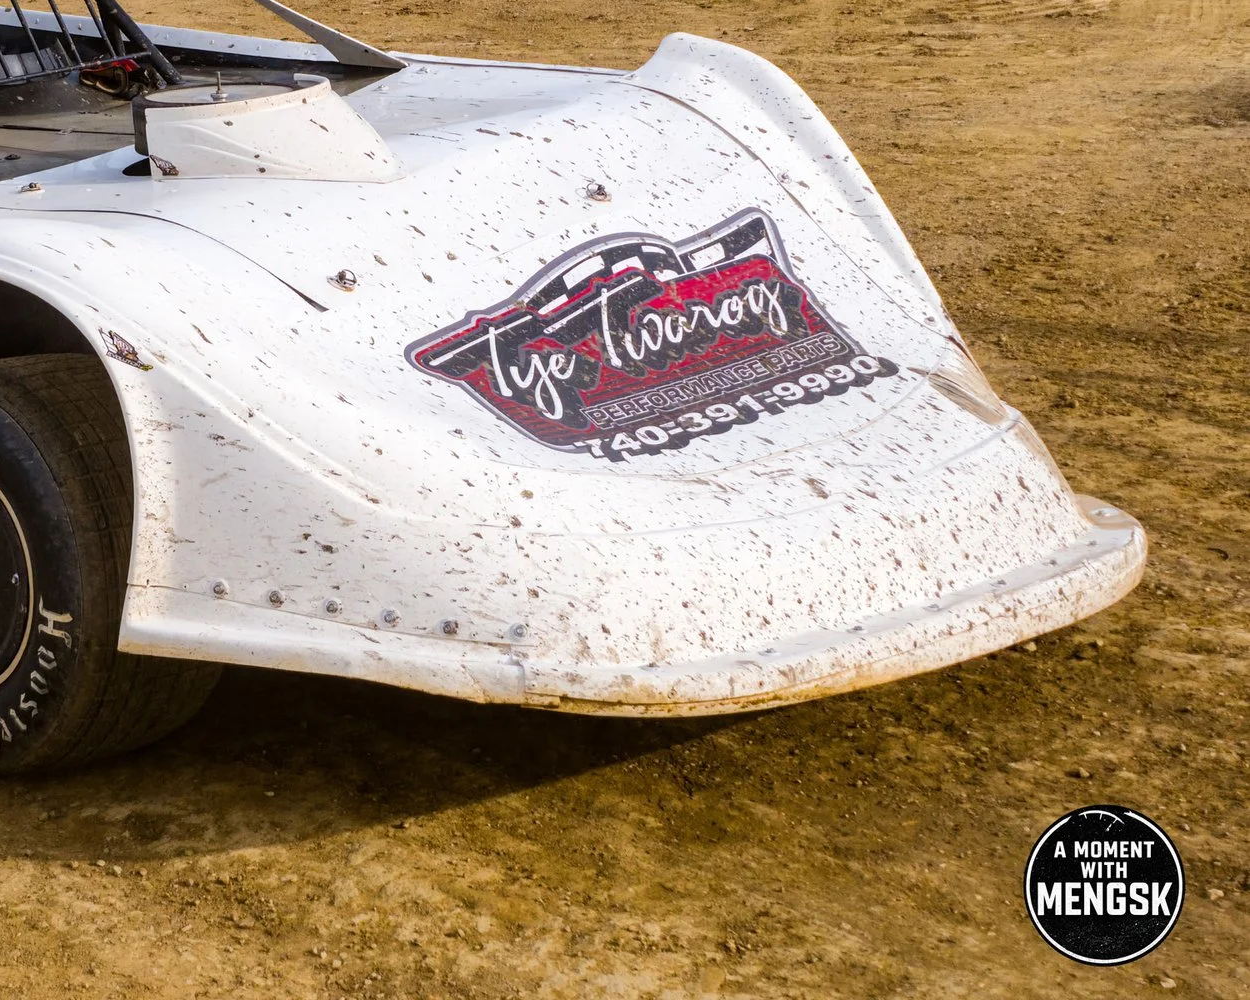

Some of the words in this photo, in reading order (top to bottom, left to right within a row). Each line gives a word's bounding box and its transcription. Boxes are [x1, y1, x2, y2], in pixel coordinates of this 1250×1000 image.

[429, 315, 576, 420] Tye
[543, 276, 788, 369] Twarog
[586, 358, 768, 427] PERFORMANCE
[767, 332, 842, 372] PARTS
[574, 354, 882, 458] 740-391-9990
